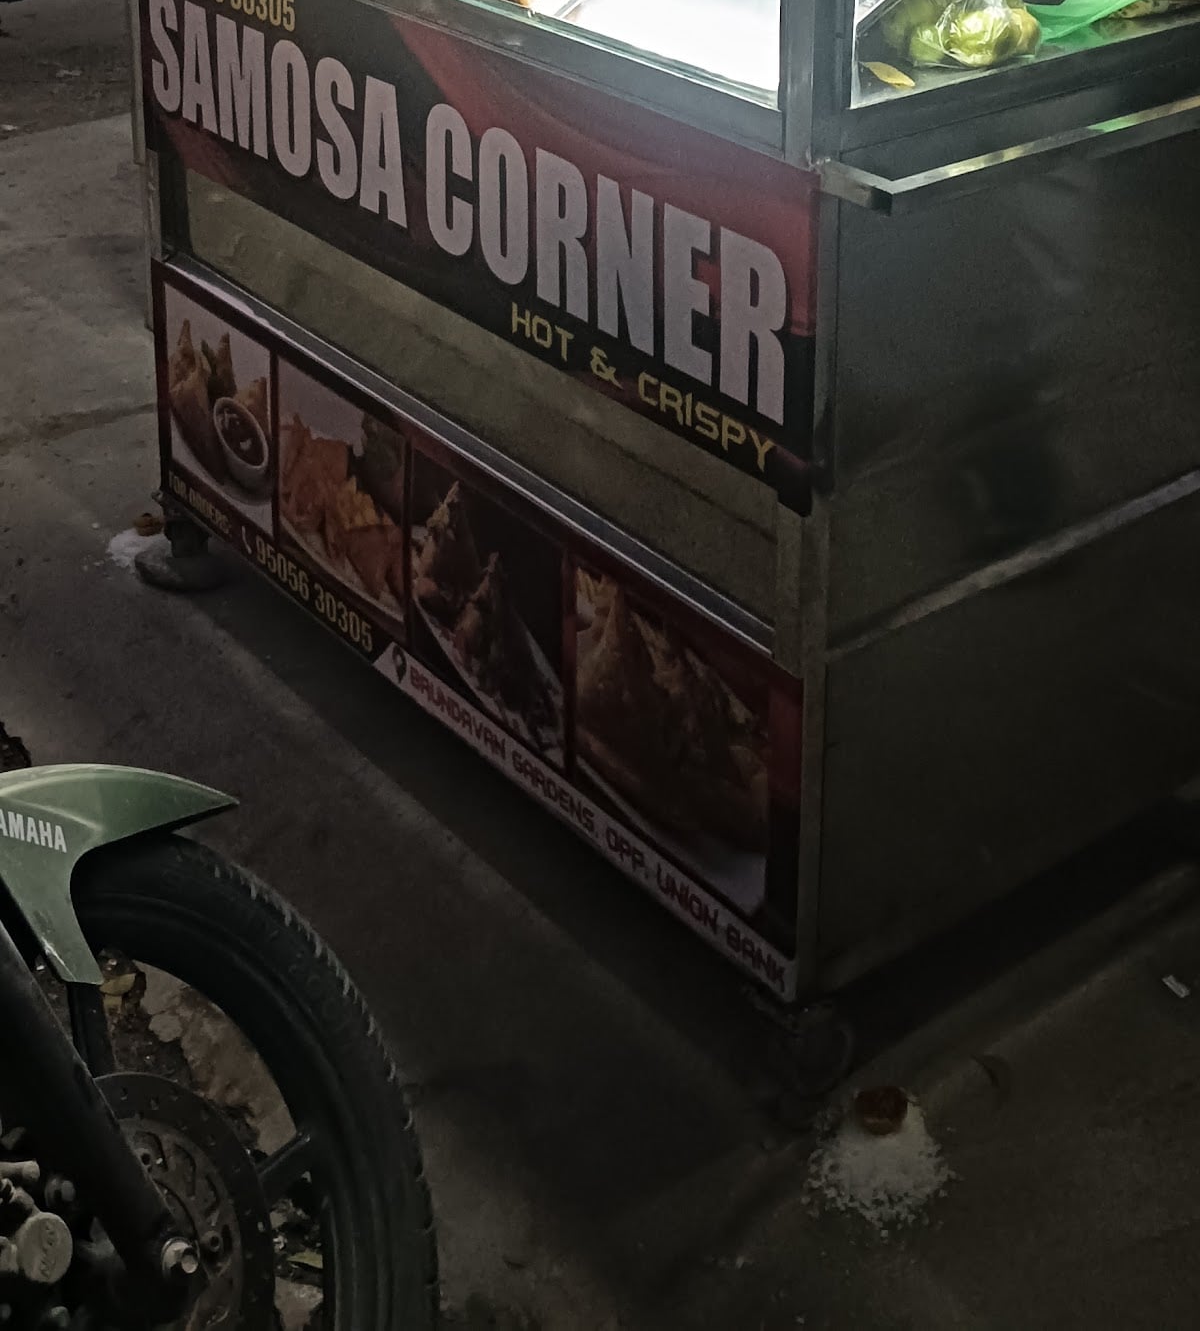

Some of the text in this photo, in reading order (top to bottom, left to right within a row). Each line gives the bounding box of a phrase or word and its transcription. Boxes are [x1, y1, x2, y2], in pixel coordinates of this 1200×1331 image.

[426, 103, 786, 426] CORNER
[511, 302, 775, 471] HOT & CRISPY
[255, 537, 373, 652] 95056 30305
[410, 667, 506, 760] BRUNDAVAN
[657, 864, 719, 935] UNION
[726, 924, 786, 993] BANK
